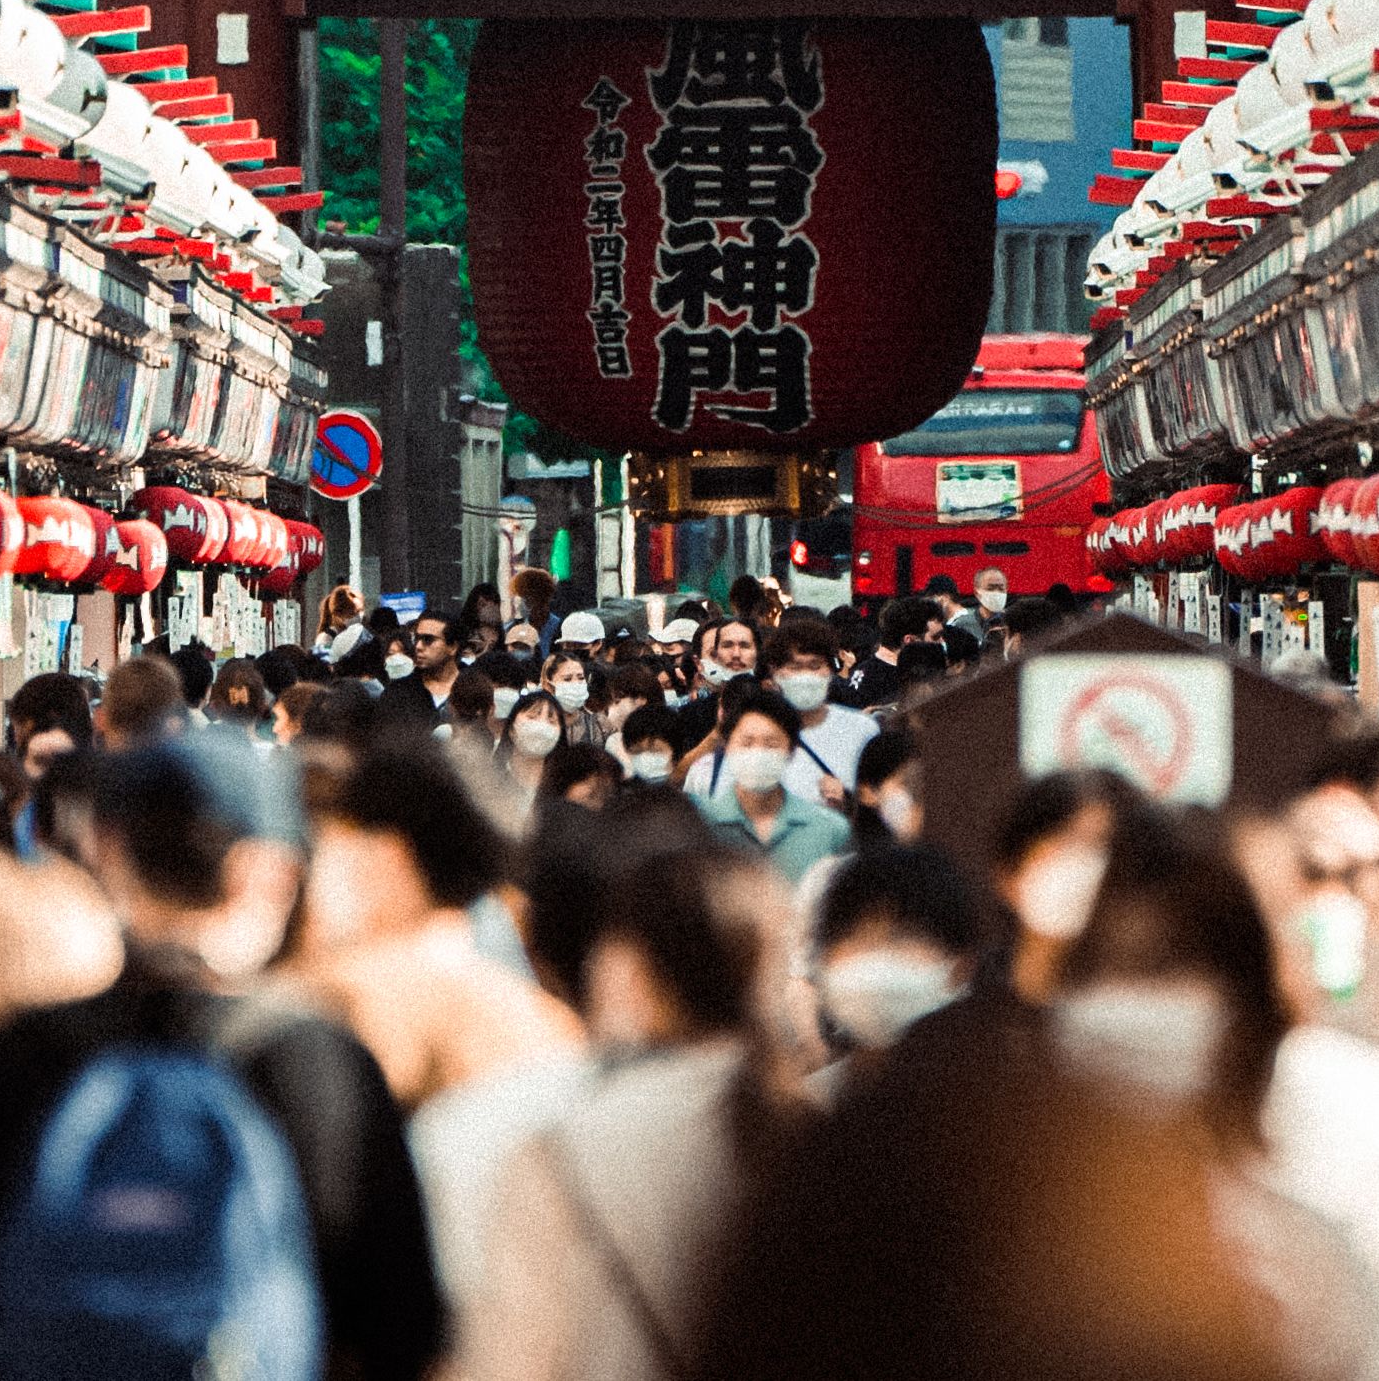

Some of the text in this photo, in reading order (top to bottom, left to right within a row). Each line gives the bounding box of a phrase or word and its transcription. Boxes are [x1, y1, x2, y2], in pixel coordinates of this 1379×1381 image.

[581, 75, 633, 380] 令和二年四月吉日
[643, 20, 827, 434] 風雷神門
